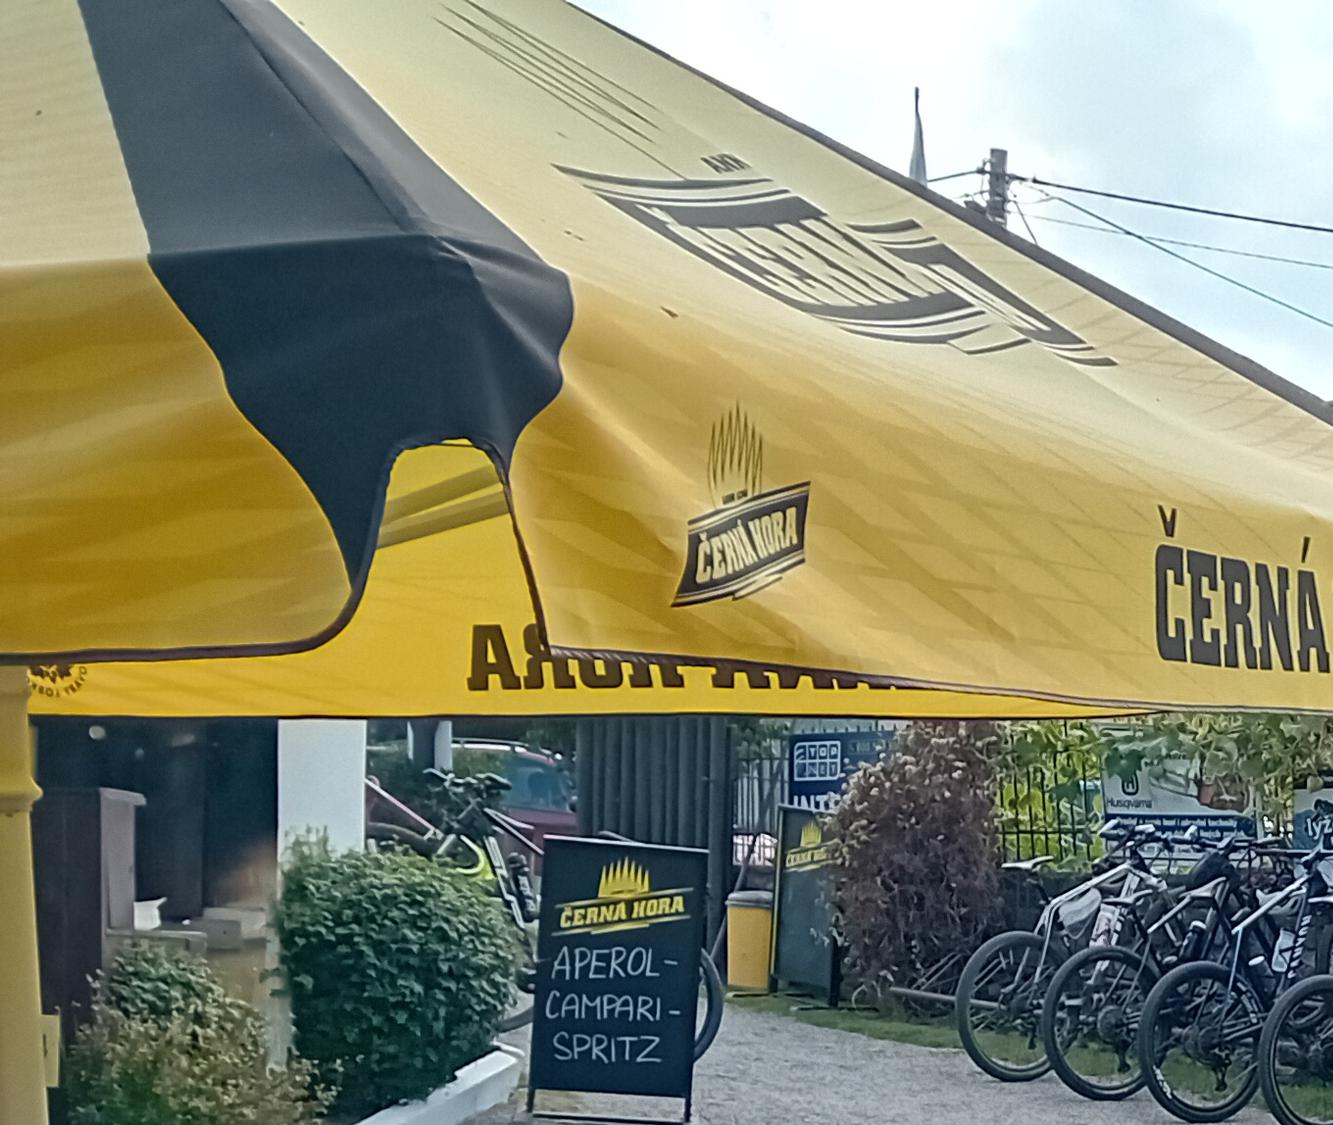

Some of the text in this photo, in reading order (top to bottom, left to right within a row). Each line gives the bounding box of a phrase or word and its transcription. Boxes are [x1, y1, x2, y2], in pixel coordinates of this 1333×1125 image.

[696, 507, 798, 584] ČERNÁ HORA
[1155, 504, 1331, 674] ČERNÁ
[1106, 800, 1153, 817] Husqvarna
[560, 895, 686, 929] ČERNÁ HORA
[553, 1031, 662, 1064] SPRITZ
